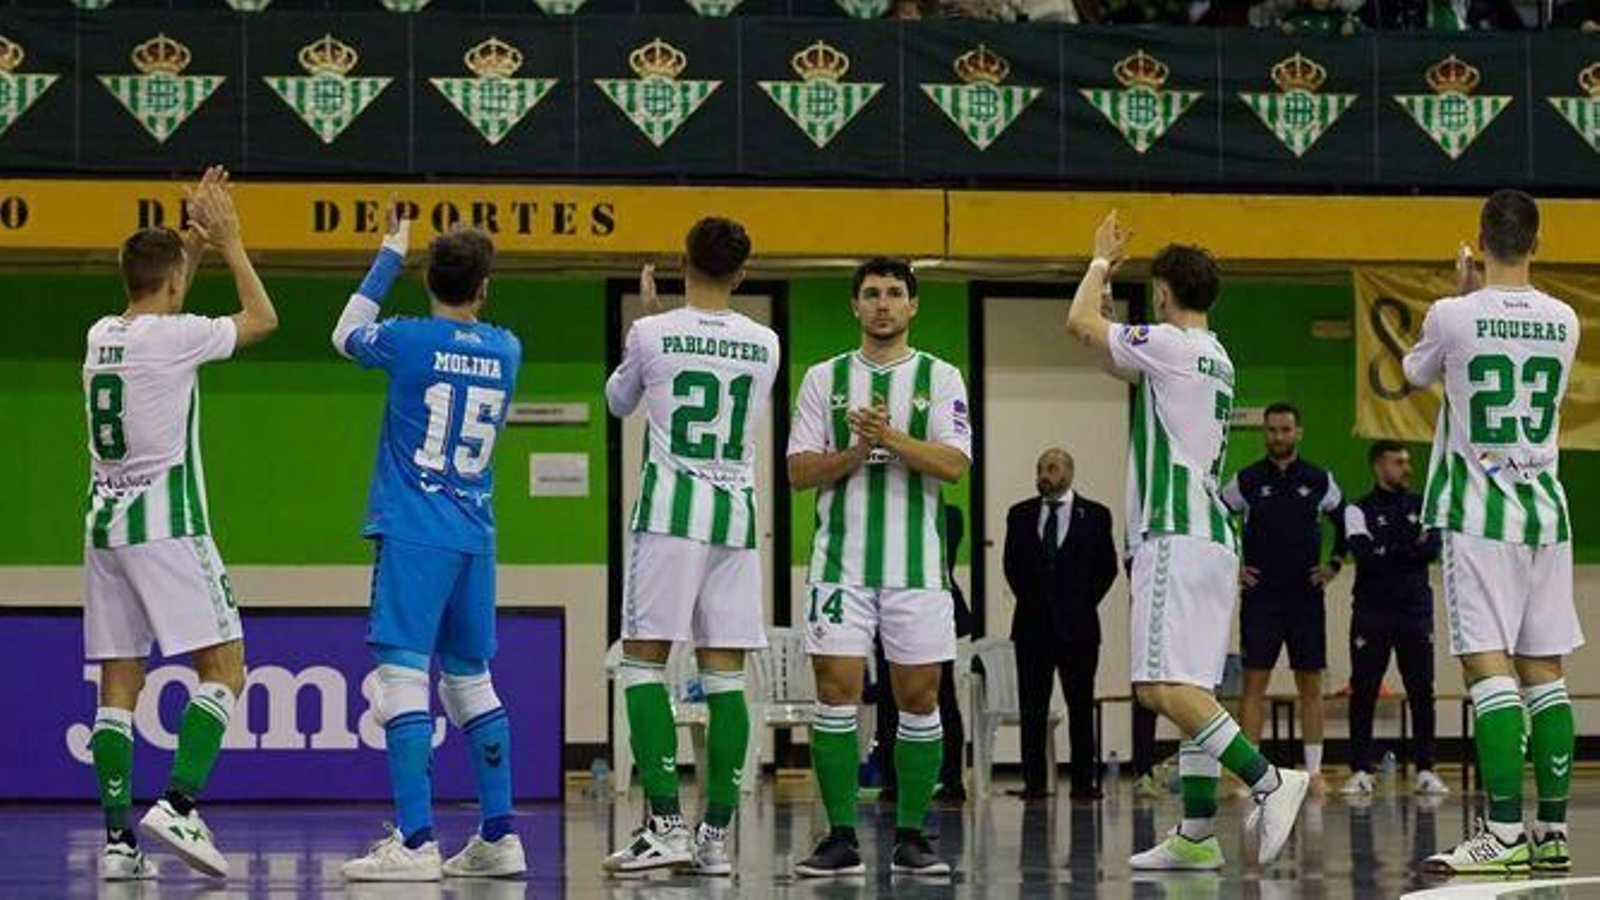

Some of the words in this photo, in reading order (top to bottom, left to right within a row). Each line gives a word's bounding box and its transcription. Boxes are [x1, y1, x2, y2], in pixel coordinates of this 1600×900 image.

[137, 199, 191, 230] D
[312, 200, 616, 236] DEPORTES
[1476, 319, 1567, 342] PIQUERAS
[434, 351, 502, 379] MOLINA
[91, 373, 127, 460] 8
[413, 382, 507, 479] 15
[671, 370, 753, 460] 21
[1467, 354, 1563, 444] 23
[808, 585, 845, 624] 14
